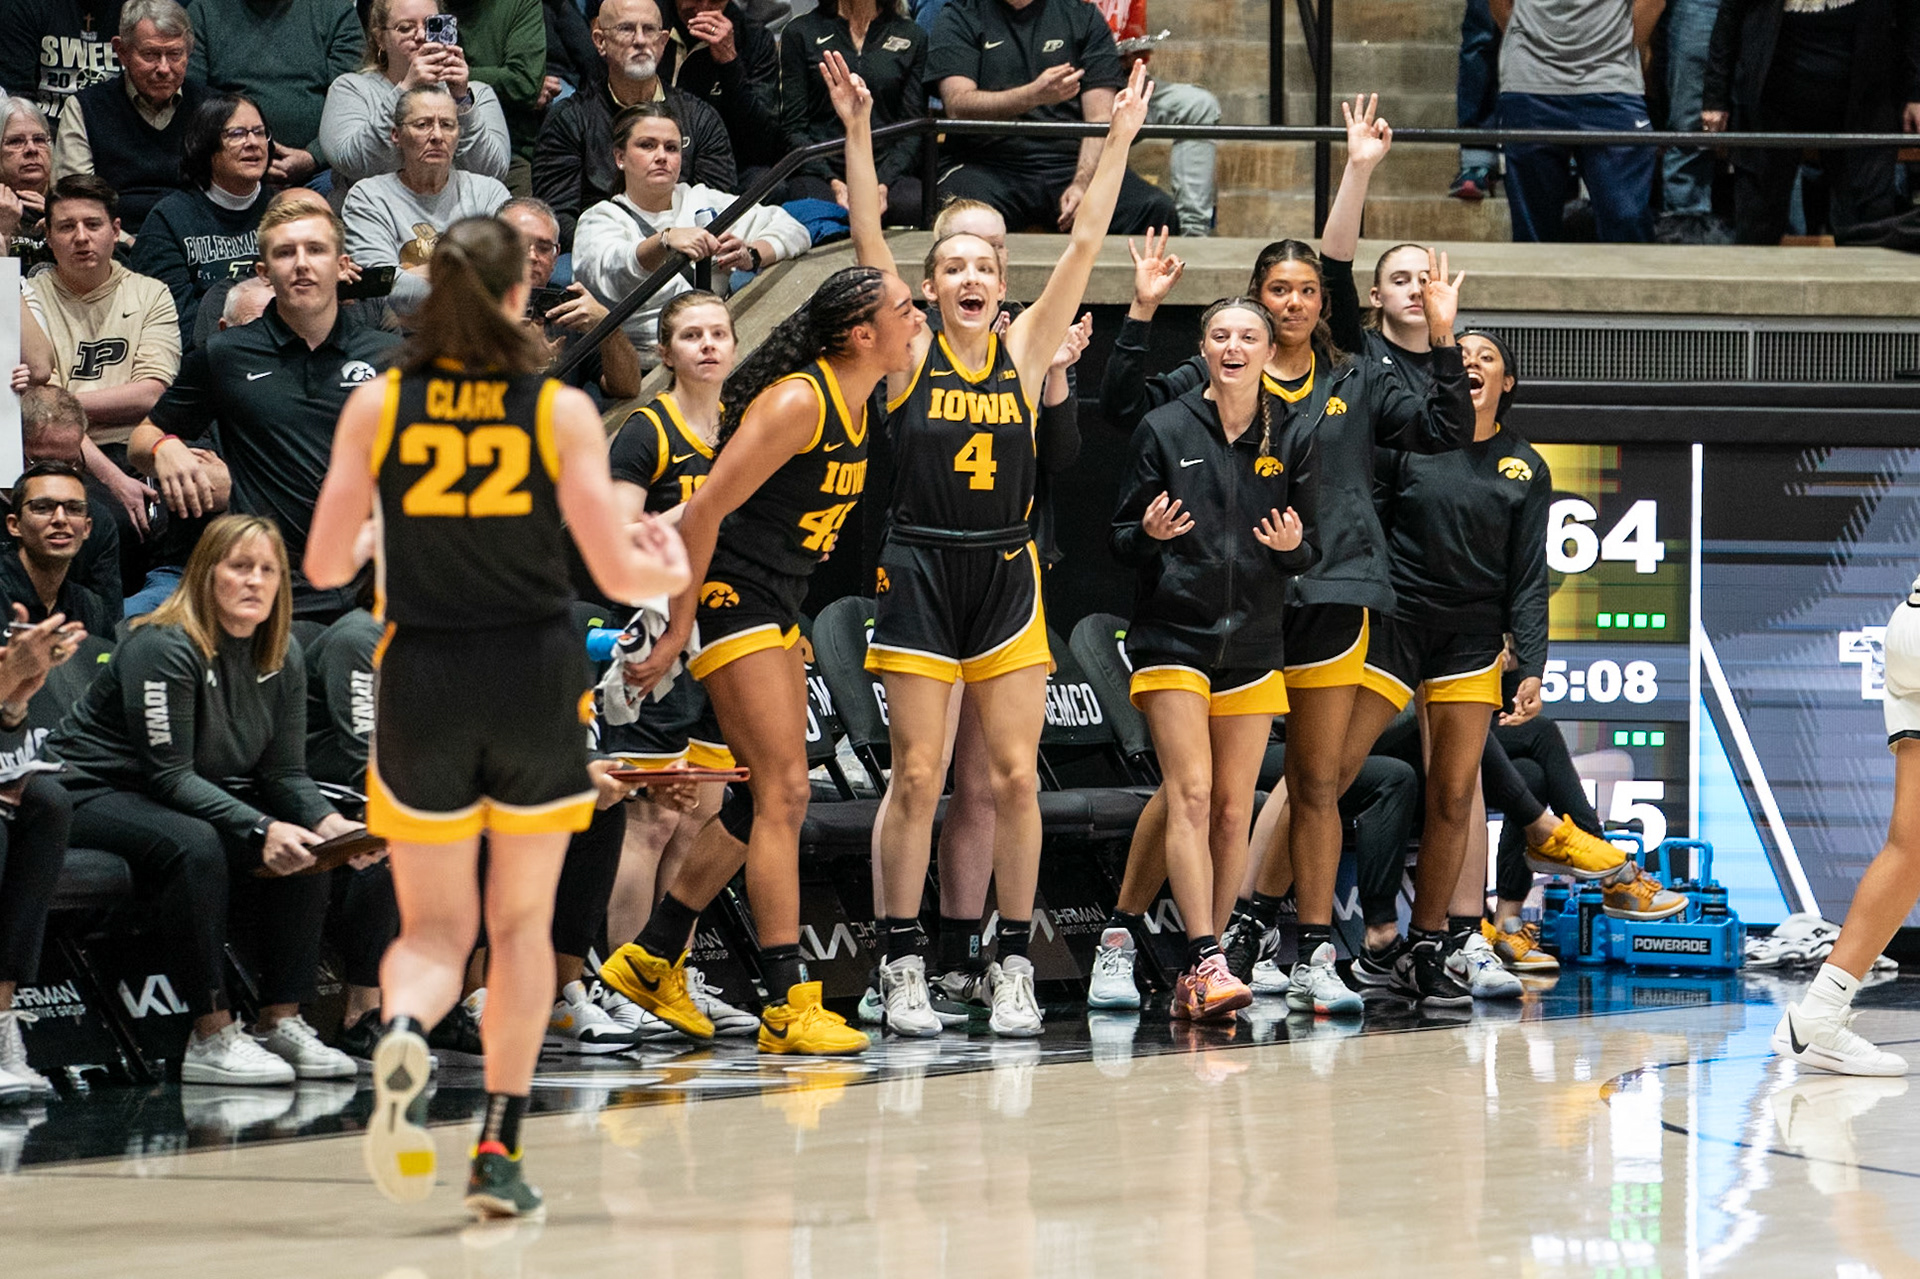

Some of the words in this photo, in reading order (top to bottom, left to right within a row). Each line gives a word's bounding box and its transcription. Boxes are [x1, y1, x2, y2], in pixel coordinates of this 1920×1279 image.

[40, 35, 125, 72] SWEE
[70, 337, 129, 381] P
[425, 378, 509, 419] CLARK
[928, 387, 1023, 425] IOWA
[399, 422, 532, 517] 22
[819, 458, 868, 496] IOW
[953, 432, 998, 491] 4
[1545, 498, 1665, 574] 64
[351, 669, 376, 735] IOWA
[1539, 659, 1659, 704] 5:08
[143, 680, 173, 747] IOWA
[1580, 778, 1667, 854] 5
[1634, 937, 1709, 953] POWERADE
